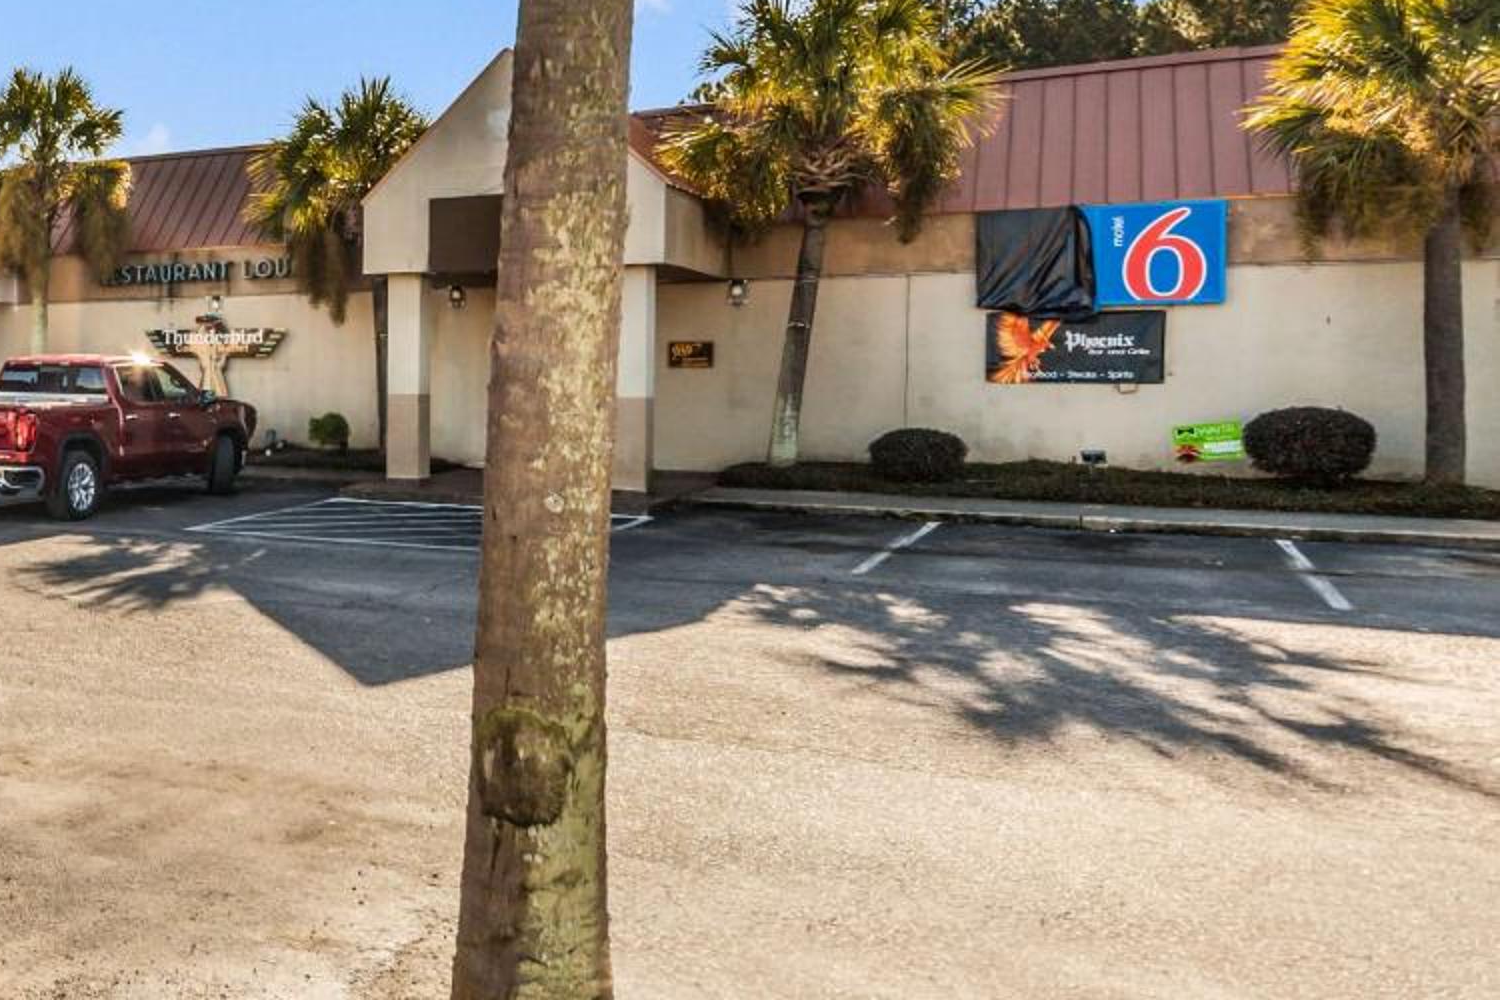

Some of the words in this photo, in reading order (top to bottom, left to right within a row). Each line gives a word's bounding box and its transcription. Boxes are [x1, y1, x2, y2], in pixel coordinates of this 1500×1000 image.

[1122, 207, 1207, 301] 6
[108, 261, 228, 284] STAURANT
[243, 255, 292, 279] LOU
[1064, 330, 1135, 352] Phoenix
